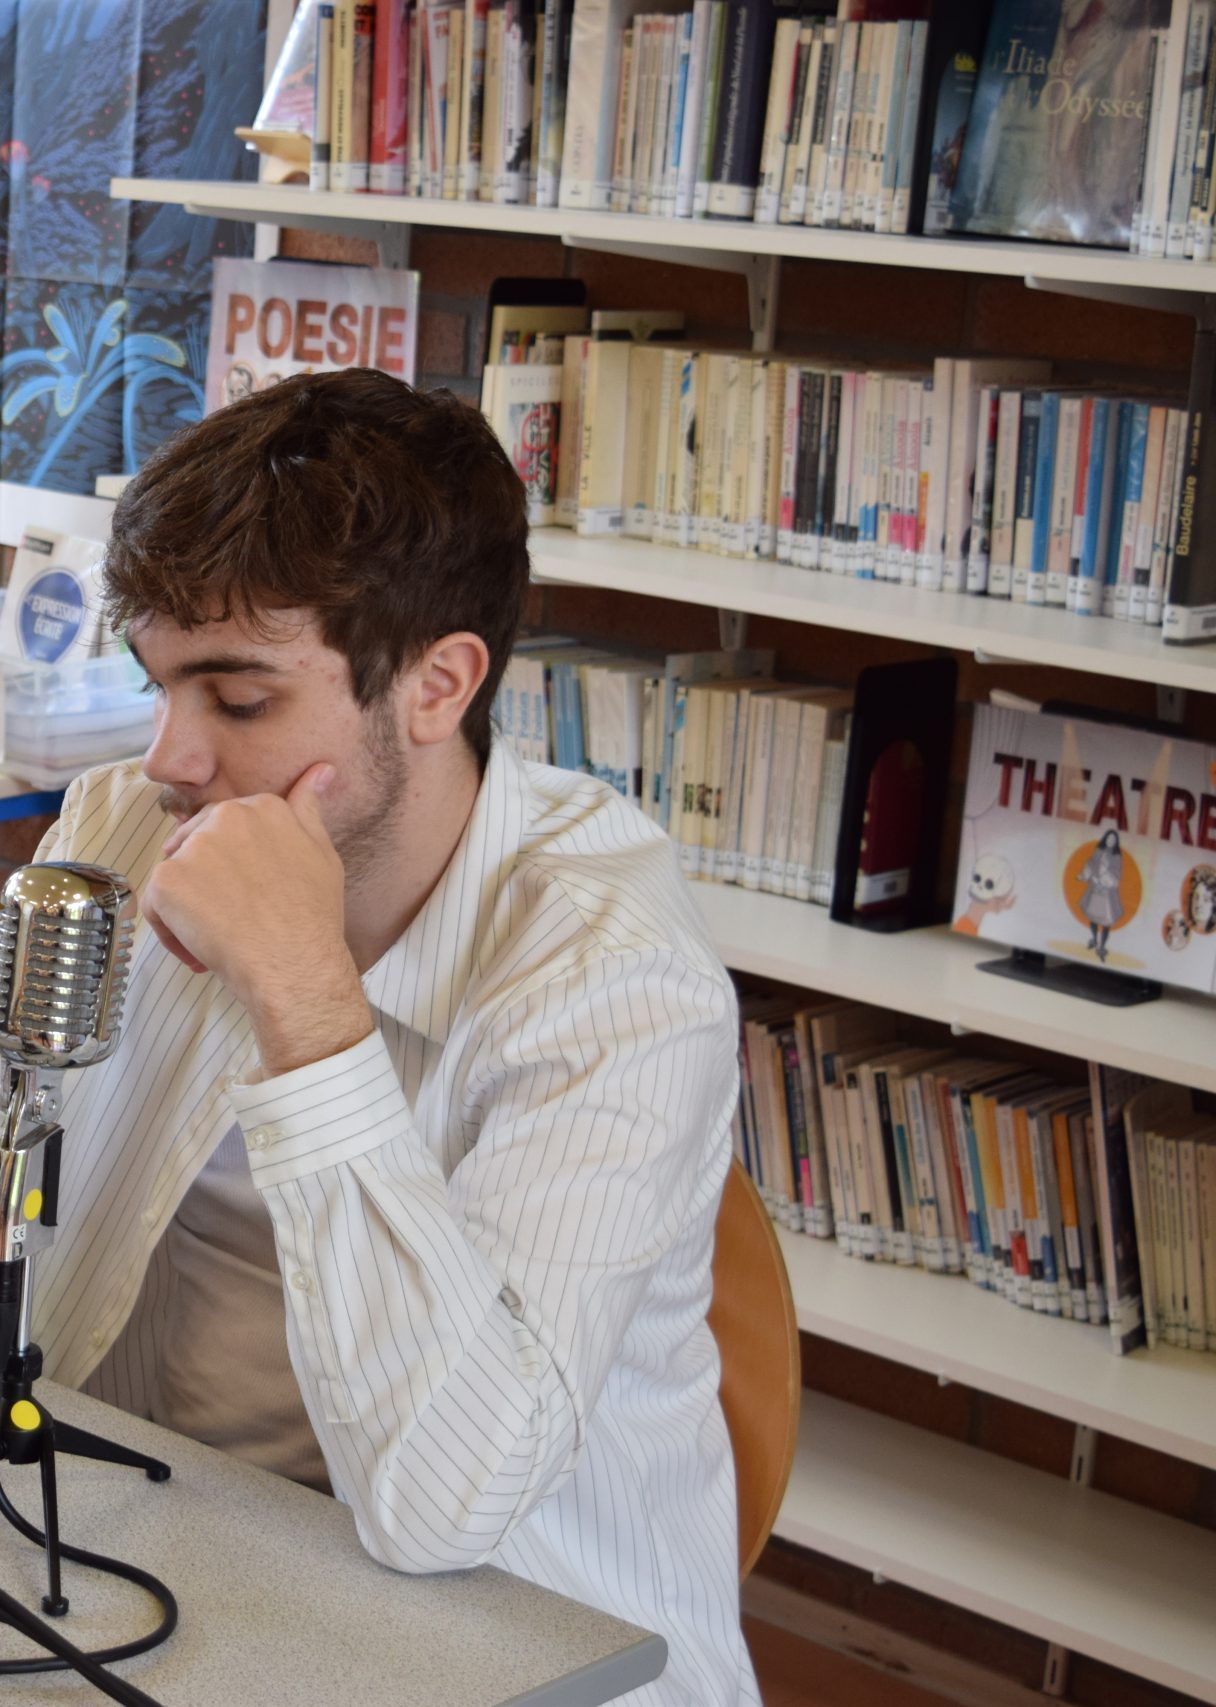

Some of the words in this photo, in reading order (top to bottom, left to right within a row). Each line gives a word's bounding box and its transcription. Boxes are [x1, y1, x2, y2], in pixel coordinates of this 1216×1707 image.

[224, 292, 407, 374] POESIE
[1176, 475, 1197, 556] Baudelaire
[993, 752, 1216, 853] THEATRE
